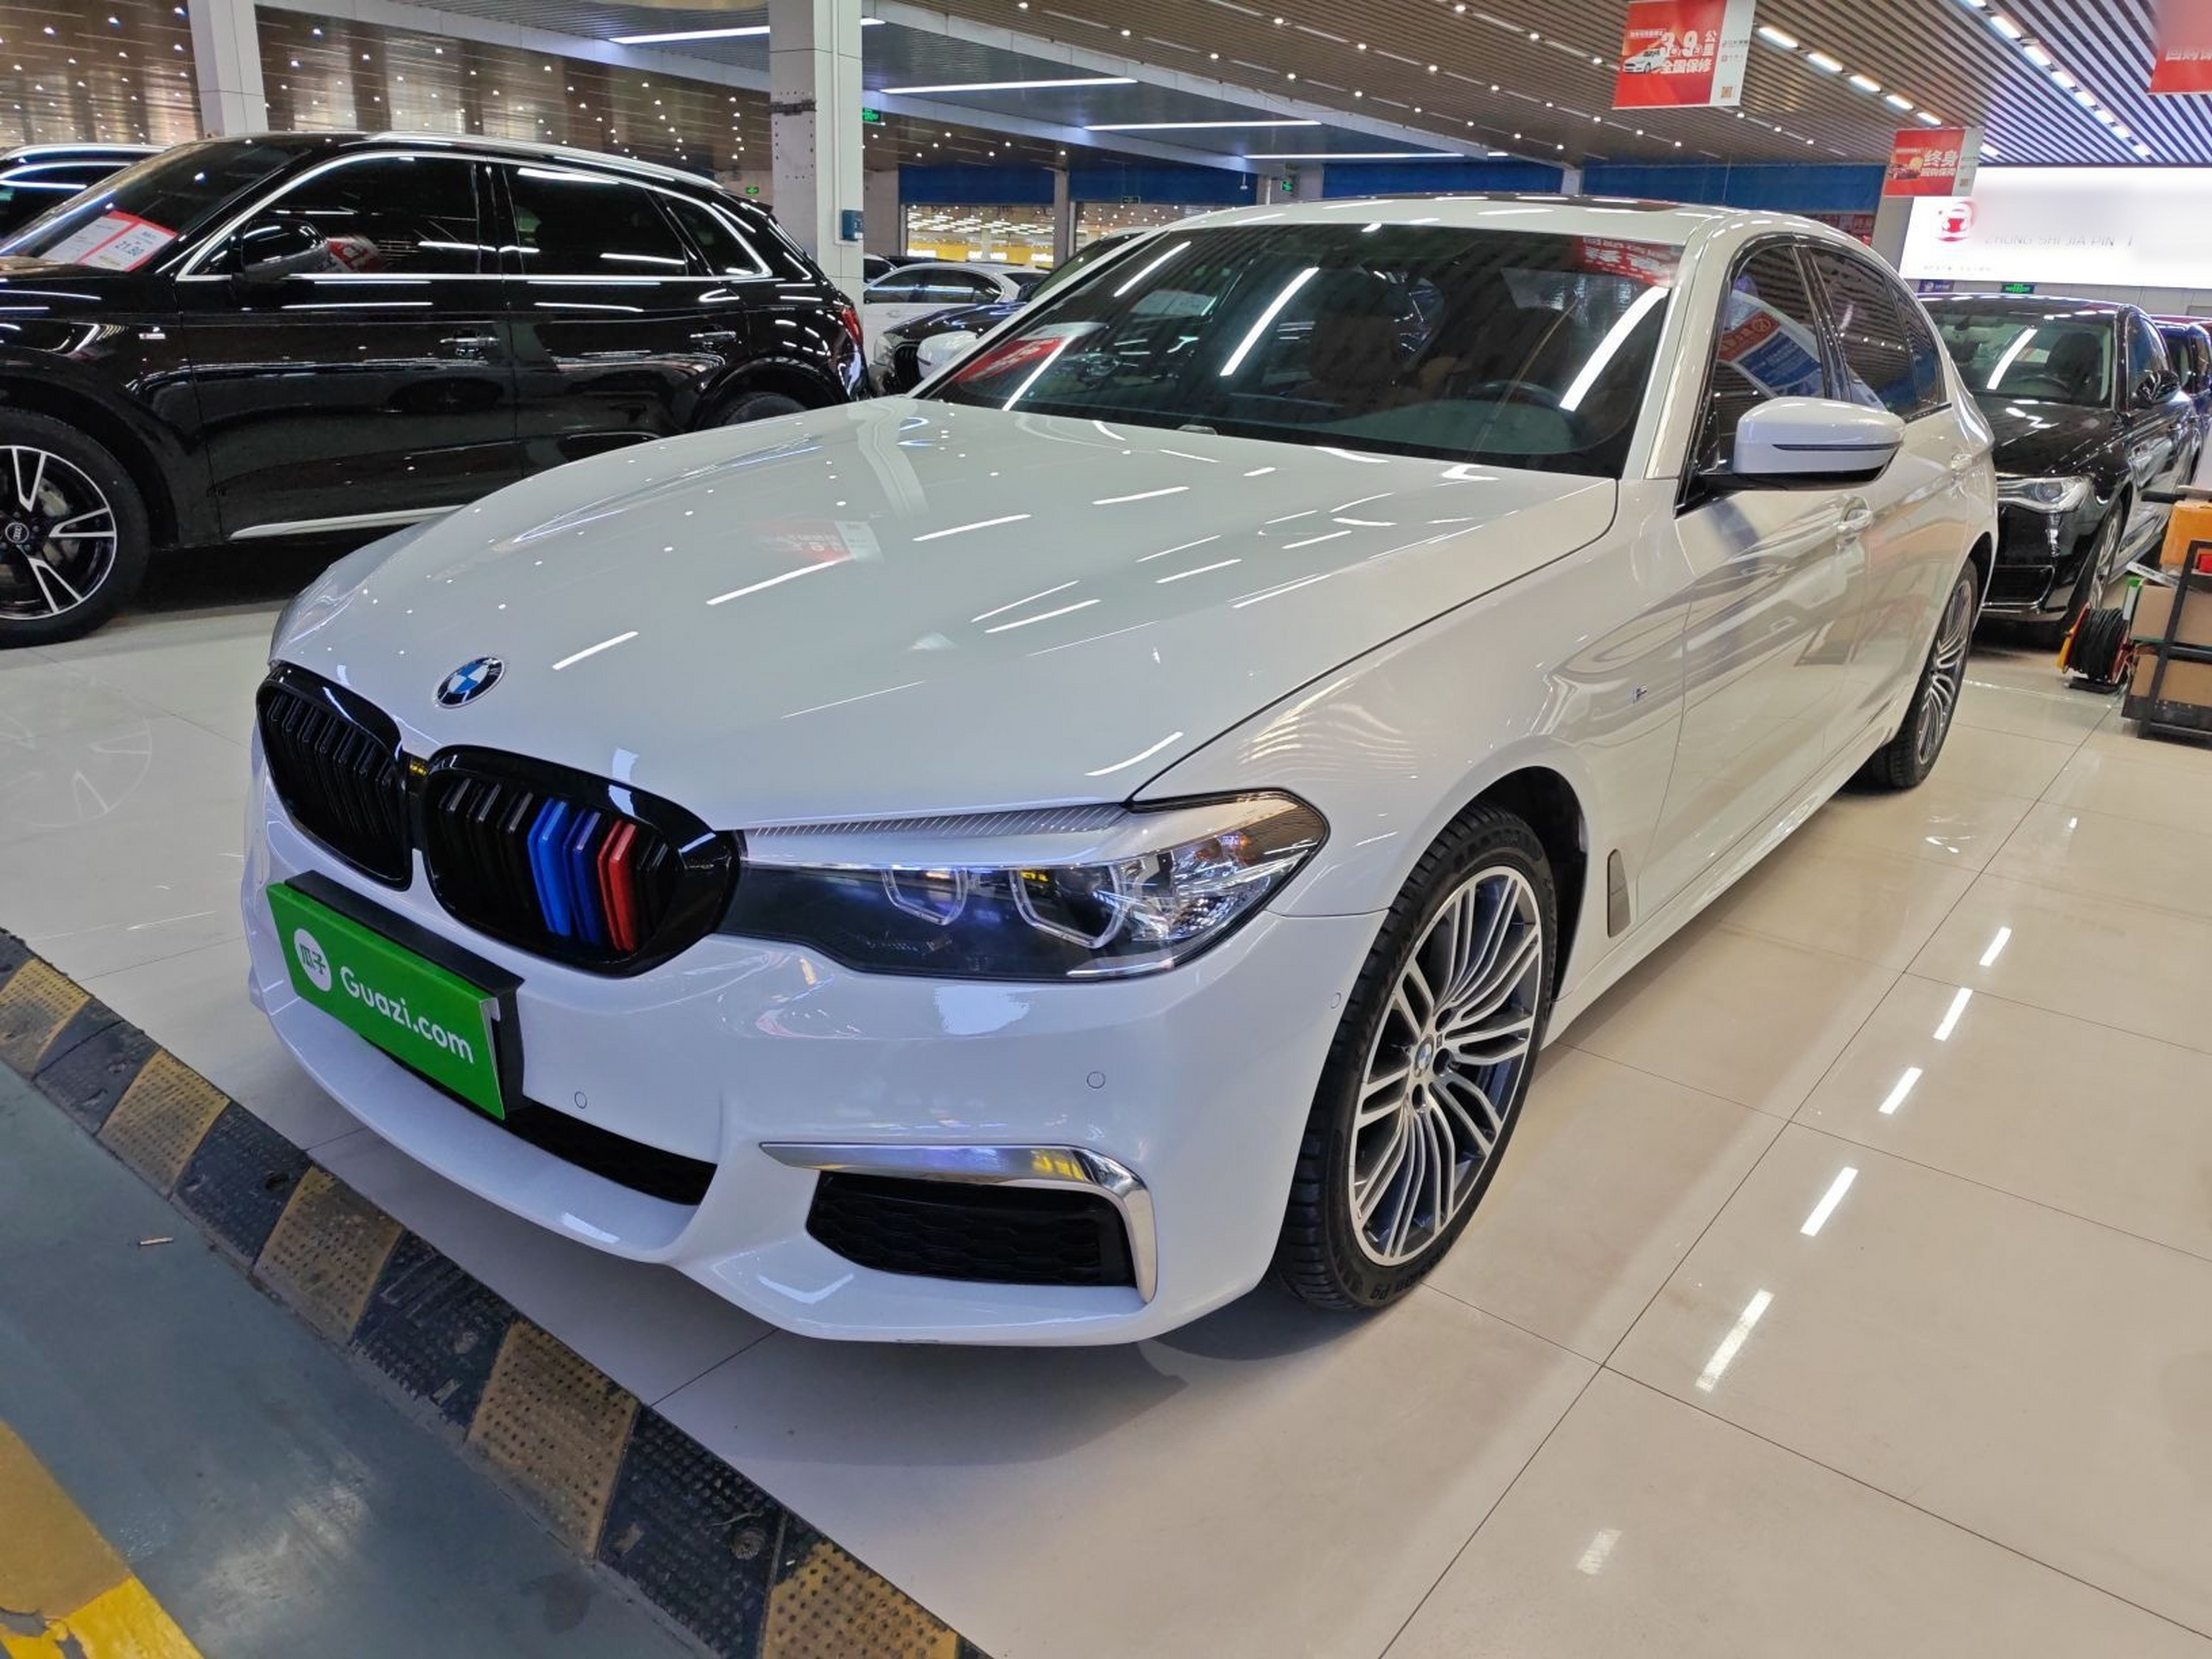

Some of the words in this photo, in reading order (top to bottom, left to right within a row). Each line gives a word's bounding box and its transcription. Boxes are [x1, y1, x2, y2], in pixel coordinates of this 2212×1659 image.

[1923, 150, 1958, 167] 终身
[299, 943, 327, 975] 瓜子
[340, 965, 474, 1064] Guazi.com
